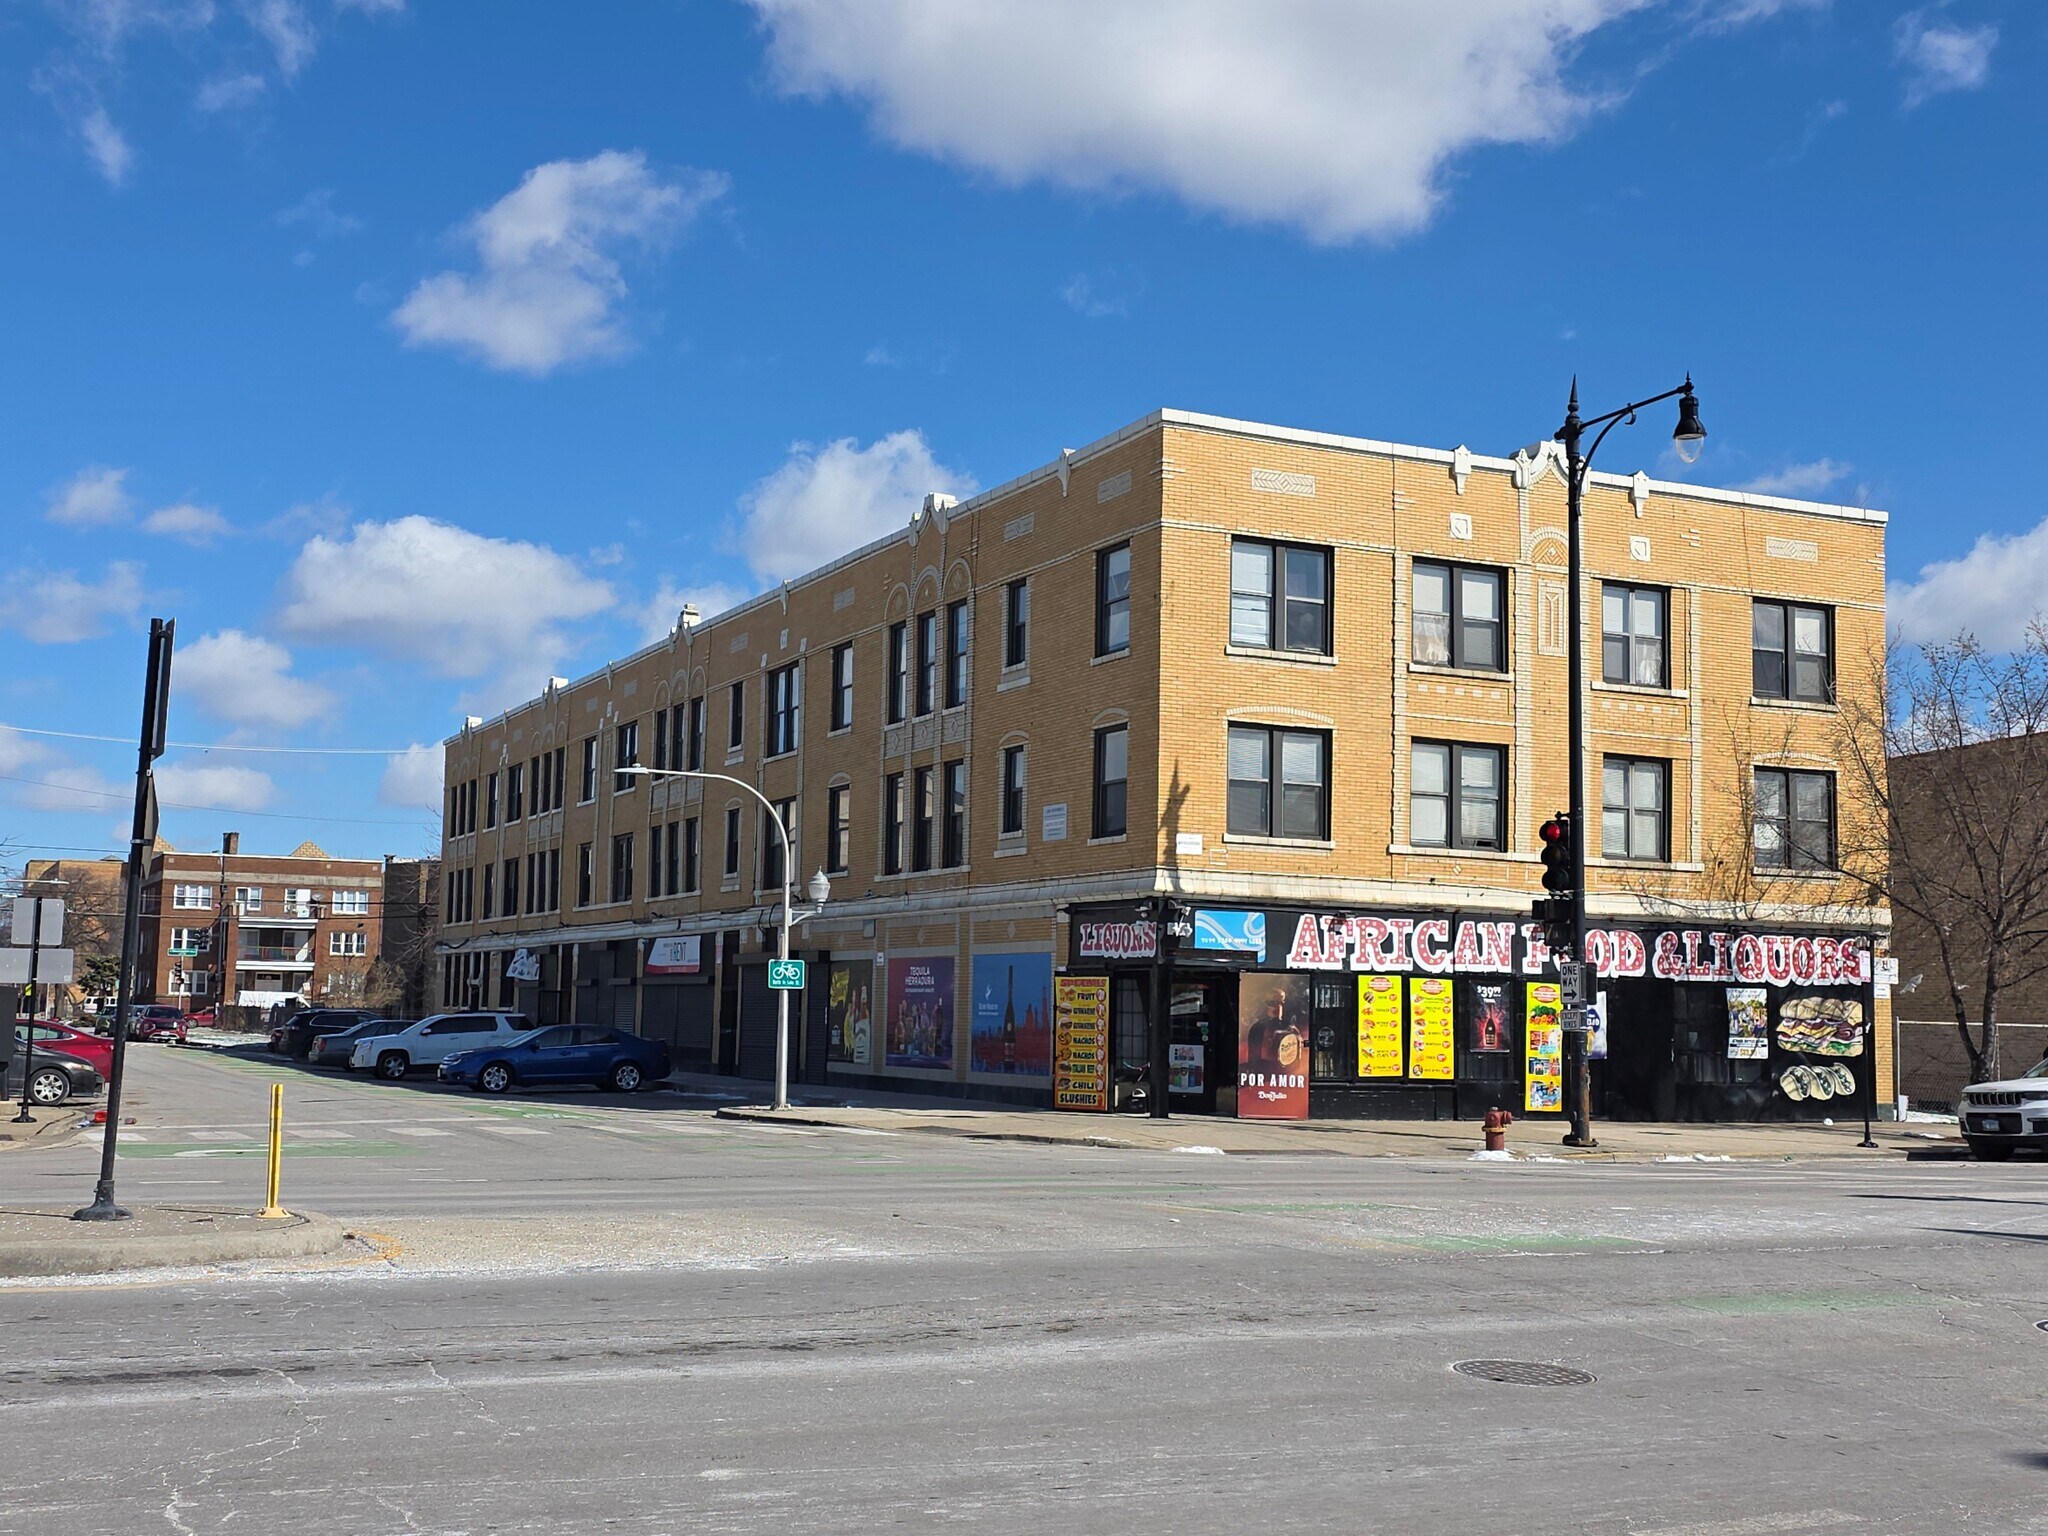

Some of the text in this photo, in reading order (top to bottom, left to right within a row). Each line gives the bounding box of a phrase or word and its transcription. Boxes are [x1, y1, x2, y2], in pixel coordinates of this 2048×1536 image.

[1080, 921, 1158, 958] LIQUORS
[1287, 914, 1515, 971] AFRICAN
[1522, 923, 1646, 977] FOD
[910, 966, 930, 976] TEQUILA
[1562, 965, 1578, 976] ONE
[905, 976, 935, 986] HERRADURA
[1562, 977, 1578, 988] WAY
[1077, 992, 1096, 1001] FRUIT
[1072, 1037, 1096, 1045] NACHOS
[1072, 1081, 1095, 1090] CHILI
[1240, 1072, 1305, 1089] POR AMOR
[1060, 1092, 1097, 1105] SLUSHIES
